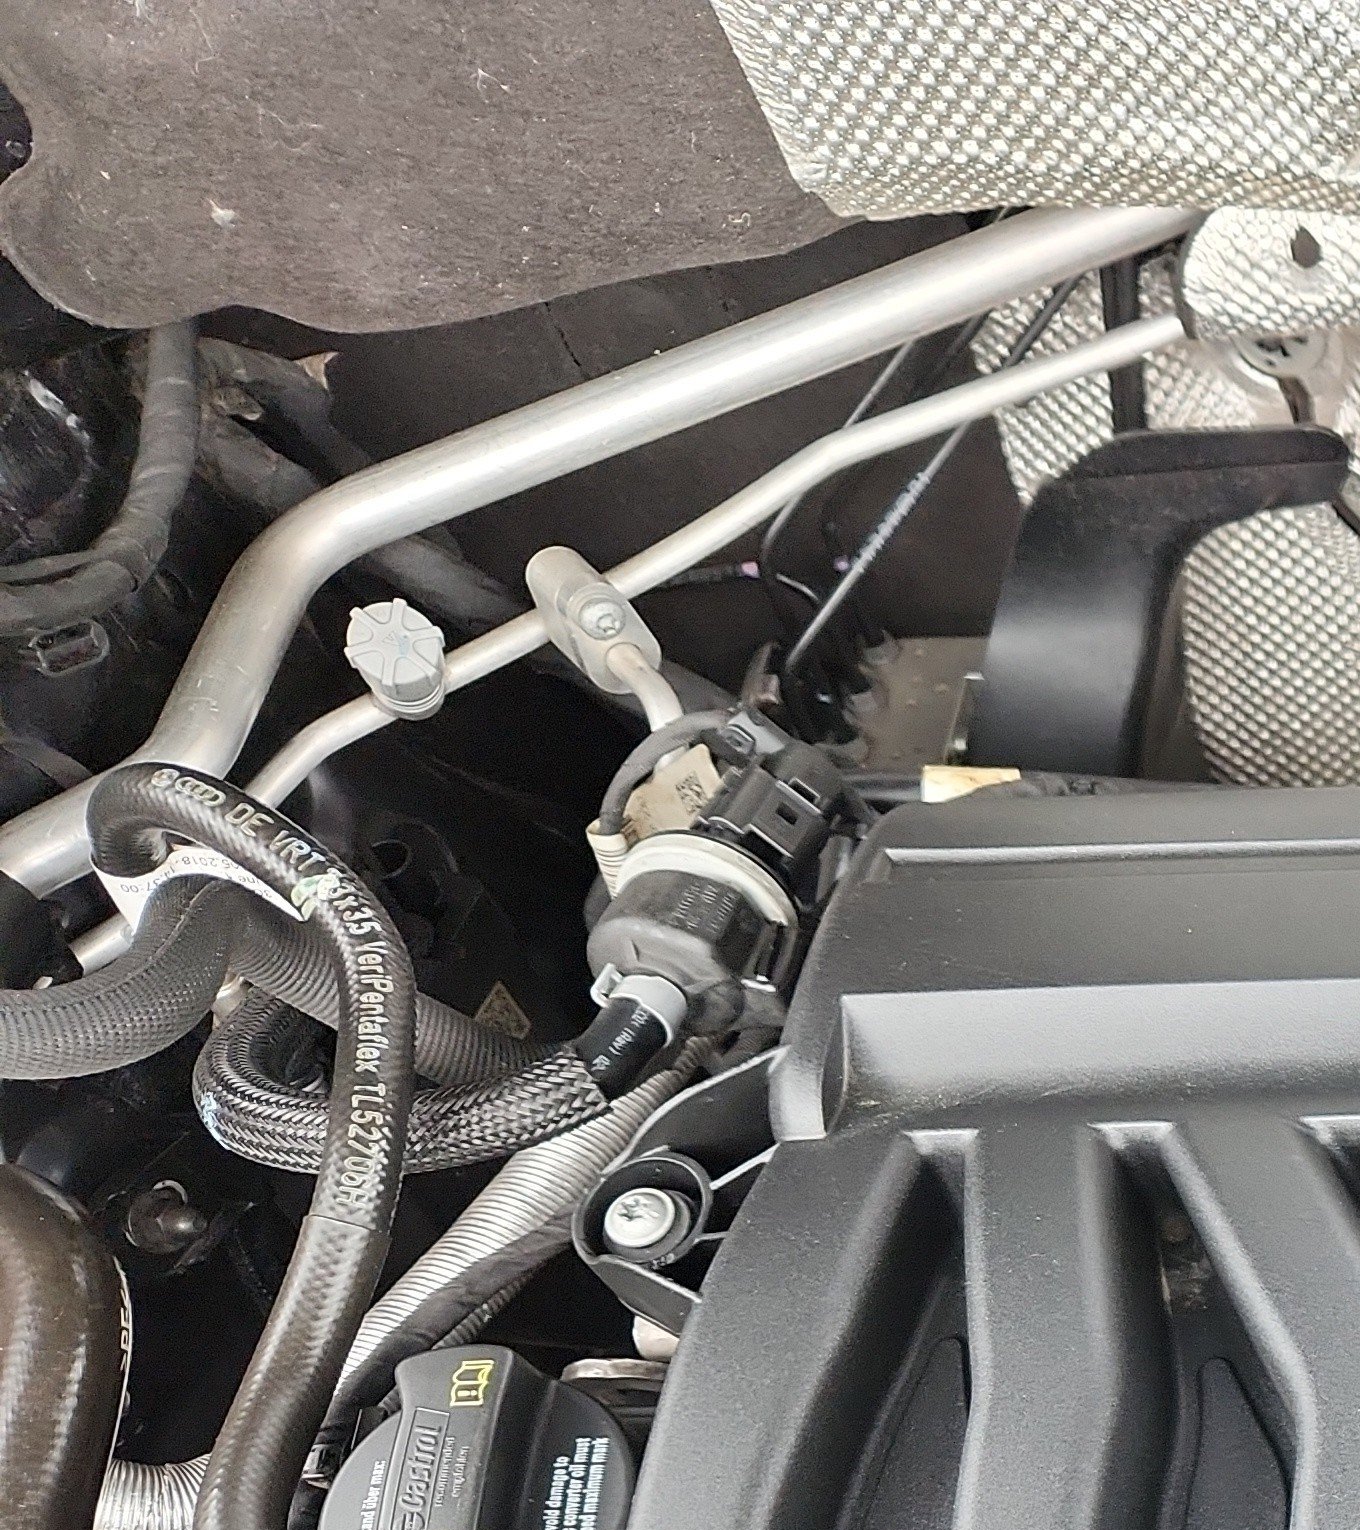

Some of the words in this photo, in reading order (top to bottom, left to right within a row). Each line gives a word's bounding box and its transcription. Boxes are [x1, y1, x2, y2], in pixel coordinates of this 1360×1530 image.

[225, 802, 274, 837] DE
[270, 830, 326, 872] VRT
[401, 1425, 442, 1512] Castrol
[435, 1436, 456, 1507] recommended
[451, 1445, 470, 1498] empfohlen
[553, 1455, 571, 1468] to
[568, 1464, 588, 1478] oil
[573, 1437, 592, 1463] must
[591, 1437, 610, 1463] mark
[362, 1485, 380, 1512] über
[545, 1468, 570, 1508] damage
[563, 1479, 585, 1527] converter
[582, 1464, 606, 1513] maximum
